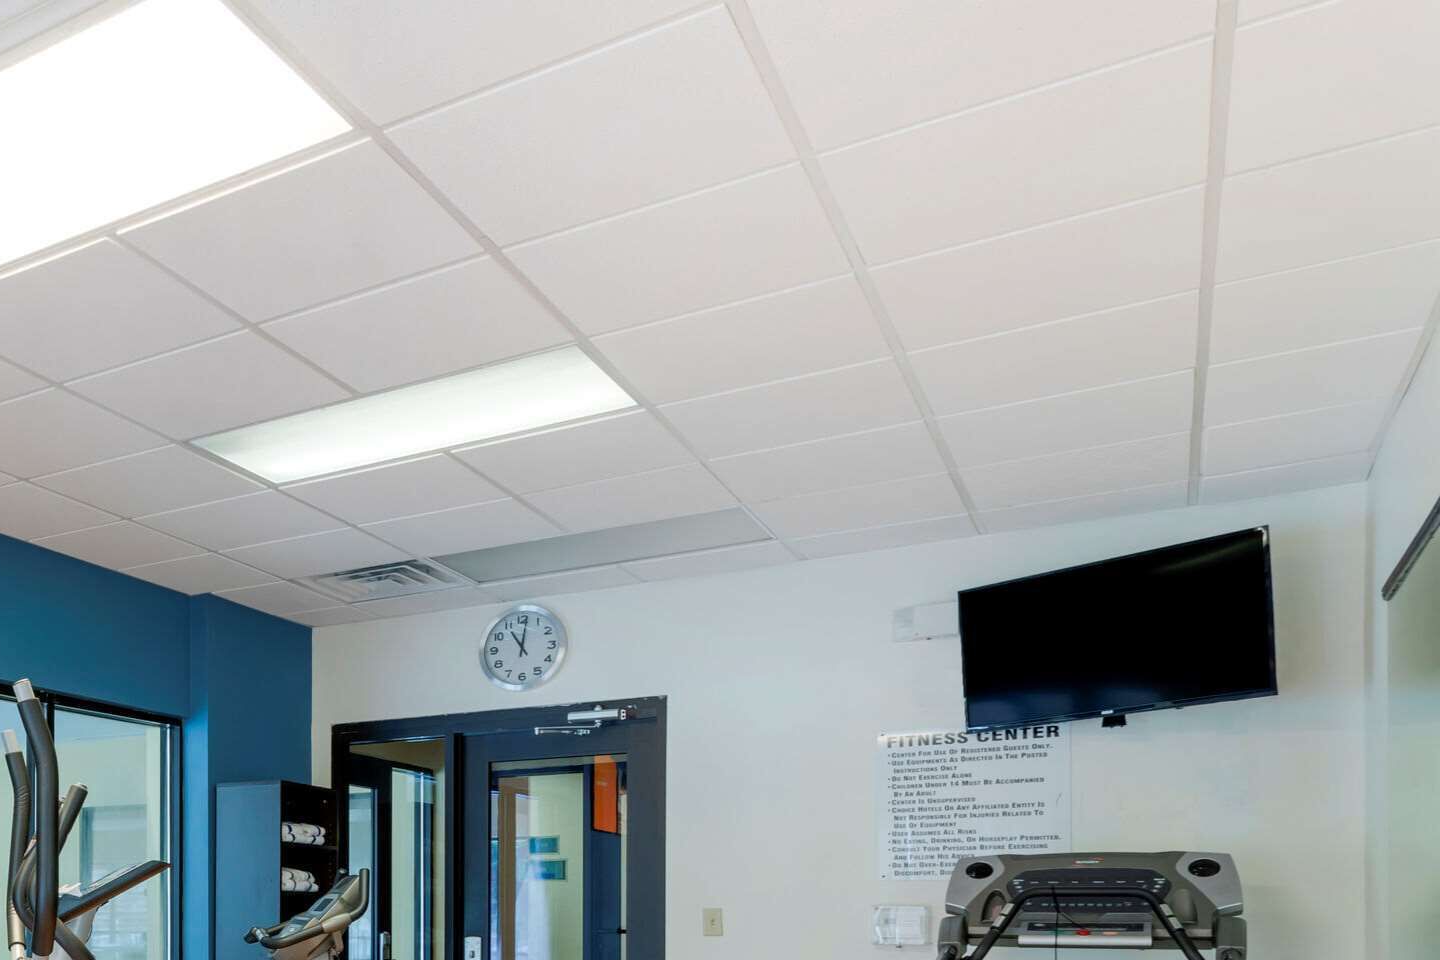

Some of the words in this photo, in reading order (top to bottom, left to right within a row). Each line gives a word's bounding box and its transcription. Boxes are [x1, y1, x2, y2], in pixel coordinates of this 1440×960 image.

[517, 615, 528, 624] 12
[536, 617, 539, 625] 1
[505, 622, 513, 630] 11
[544, 627, 552, 635] 2
[494, 632, 505, 641] 10
[547, 641, 556, 649] 3
[490, 647, 498, 655] 9
[544, 654, 552, 662] 4
[504, 669, 513, 678] 7
[533, 666, 543, 676] 5
[518, 672, 527, 681] 6
[887, 732, 969, 748] FITNESS
[976, 726, 1059, 742] CENTER
[995, 777, 1045, 785] ACCOMPANIED
